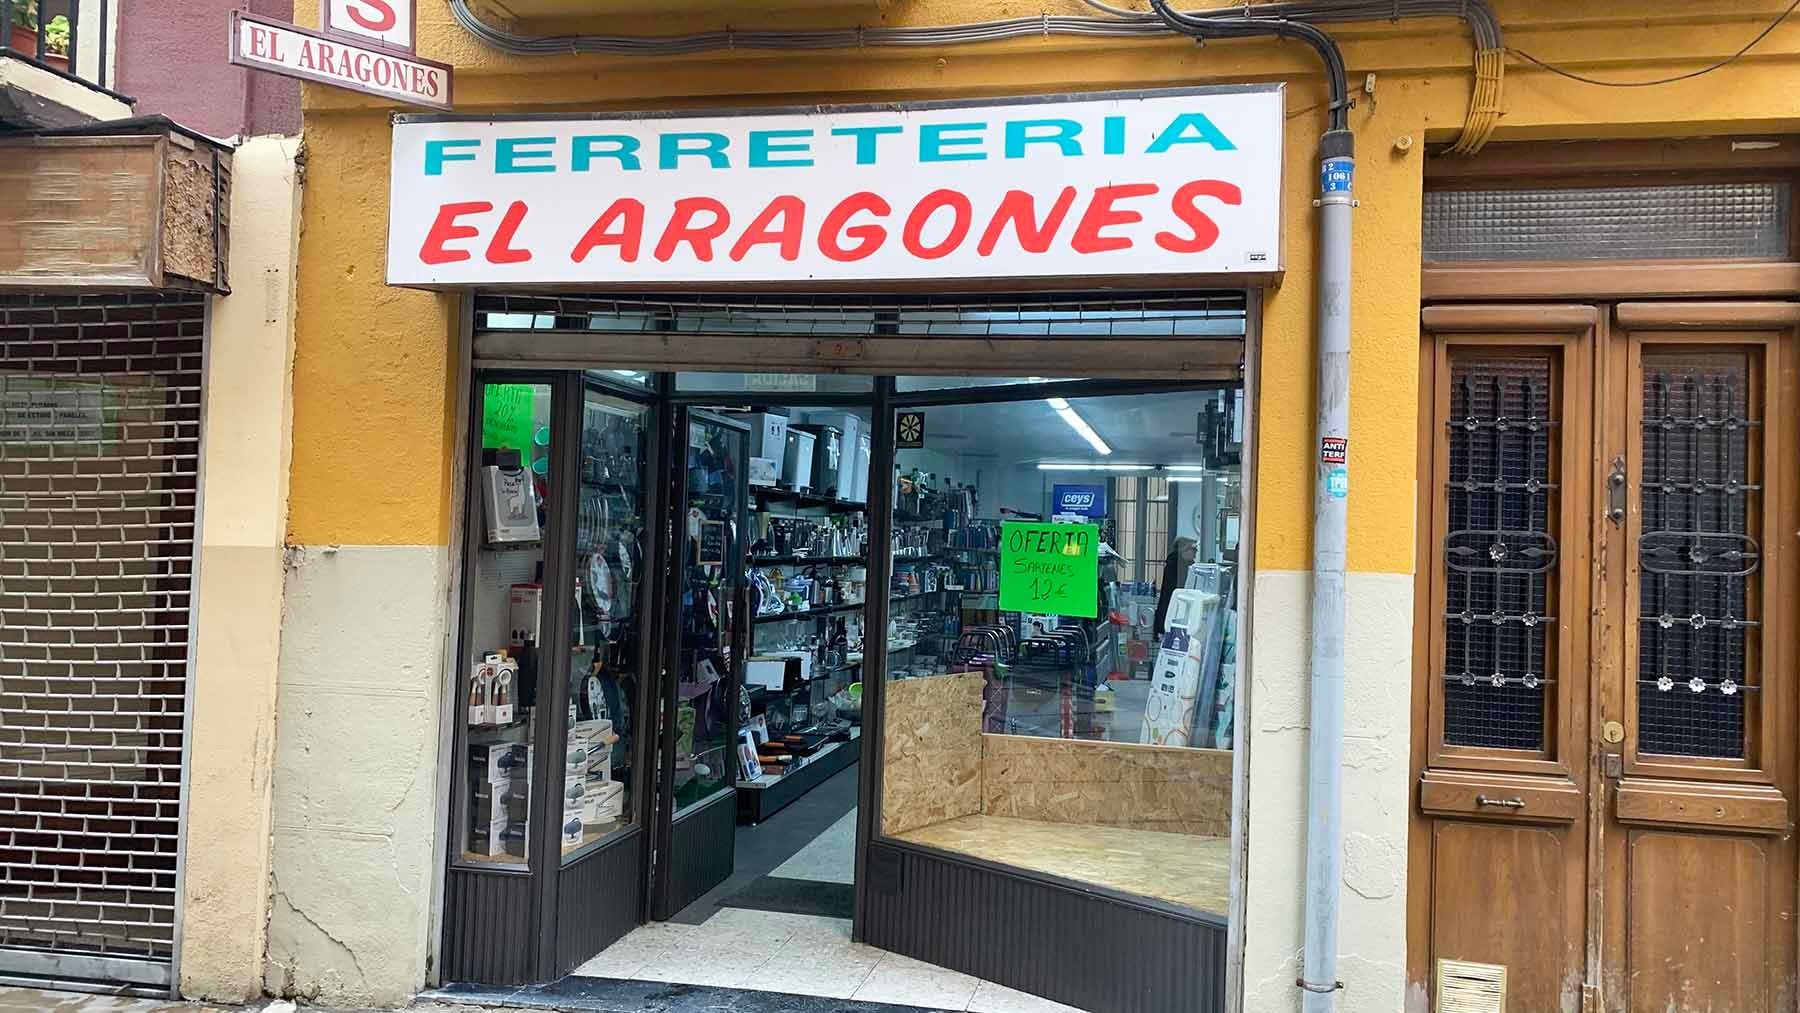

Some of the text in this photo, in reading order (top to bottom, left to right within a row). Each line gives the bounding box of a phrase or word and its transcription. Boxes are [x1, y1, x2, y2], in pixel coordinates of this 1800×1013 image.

[249, 26, 438, 98] EL ARAGONES
[424, 112, 1237, 177] FERRETERIA
[419, 180, 1243, 266] EL ARAGONES
[1323, 442, 1345, 450] ANTI
[1064, 493, 1091, 505] ceys
[1009, 529, 1088, 557] OFERTA
[1014, 558, 1074, 578] SARTENES
